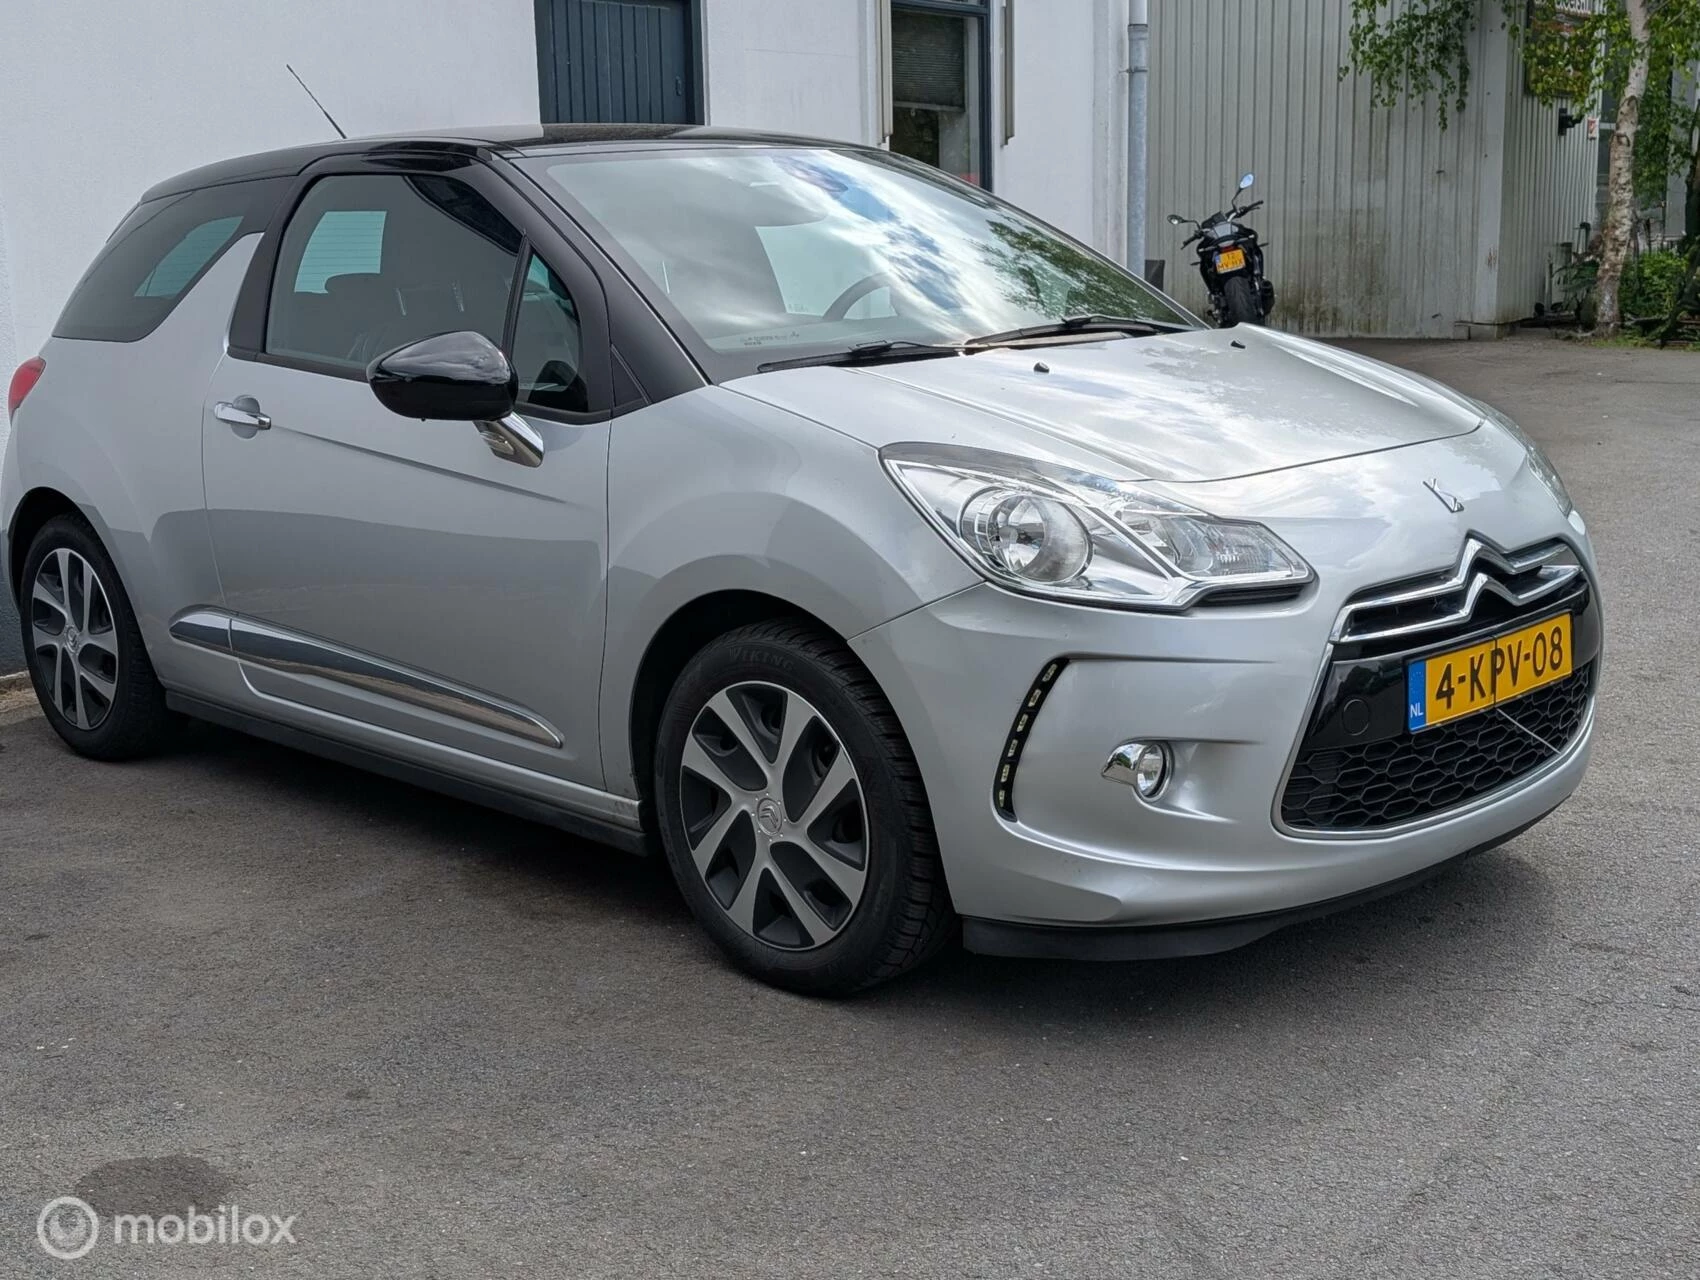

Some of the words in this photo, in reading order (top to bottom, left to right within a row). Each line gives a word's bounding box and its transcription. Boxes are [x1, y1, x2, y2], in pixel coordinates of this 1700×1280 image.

[729, 646, 796, 671] VIKING
[1436, 626, 1563, 710] 4-KPV-08
[1410, 702, 1424, 718] NL
